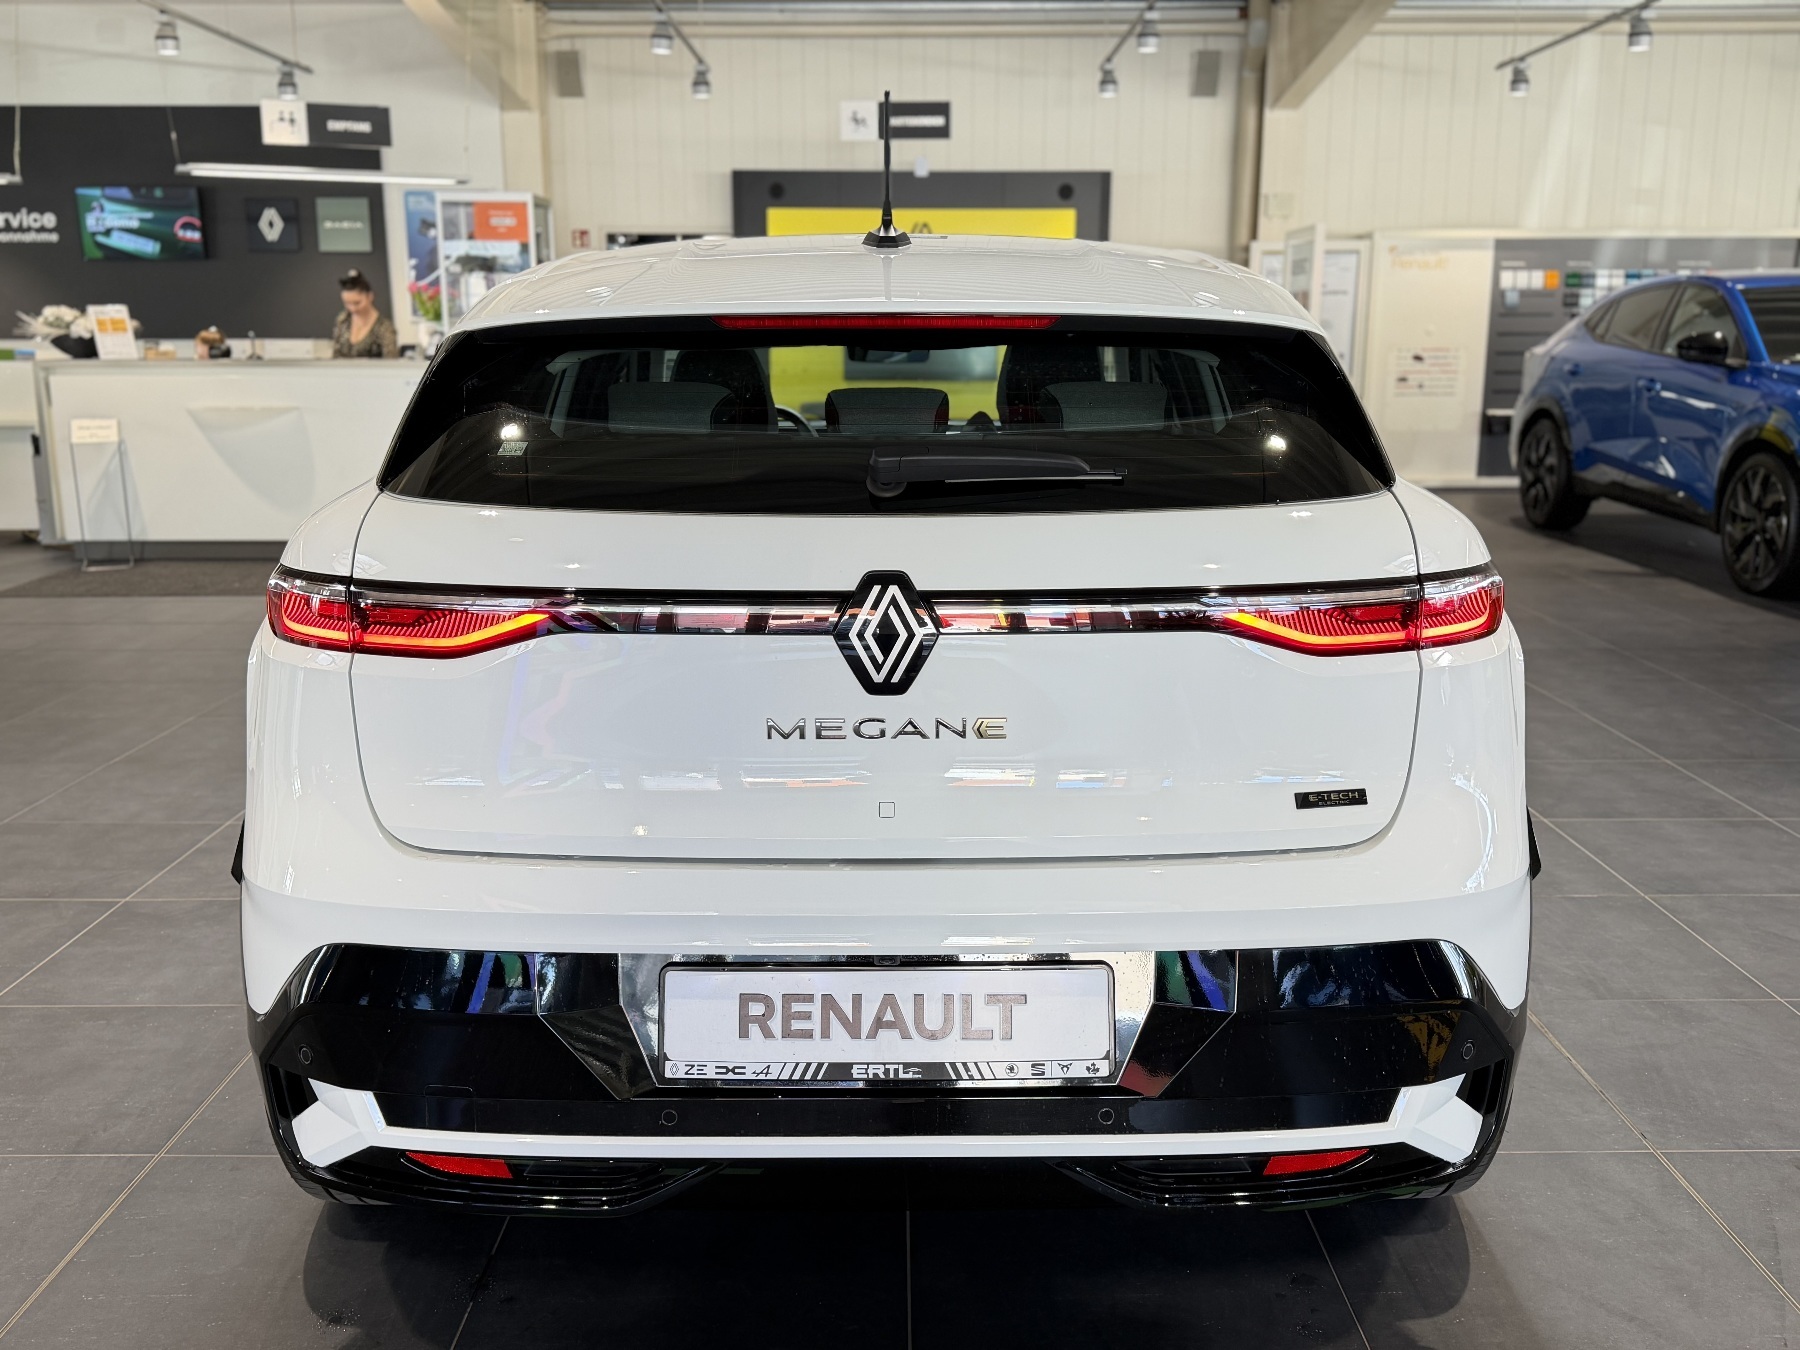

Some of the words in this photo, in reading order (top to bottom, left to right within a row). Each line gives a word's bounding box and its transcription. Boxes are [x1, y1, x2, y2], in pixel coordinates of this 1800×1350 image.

[765, 717, 1008, 740] MEGANE
[1308, 791, 1358, 801] E-TECH
[737, 993, 1027, 1041] RENAULT
[851, 1064, 914, 1079] ERTL
